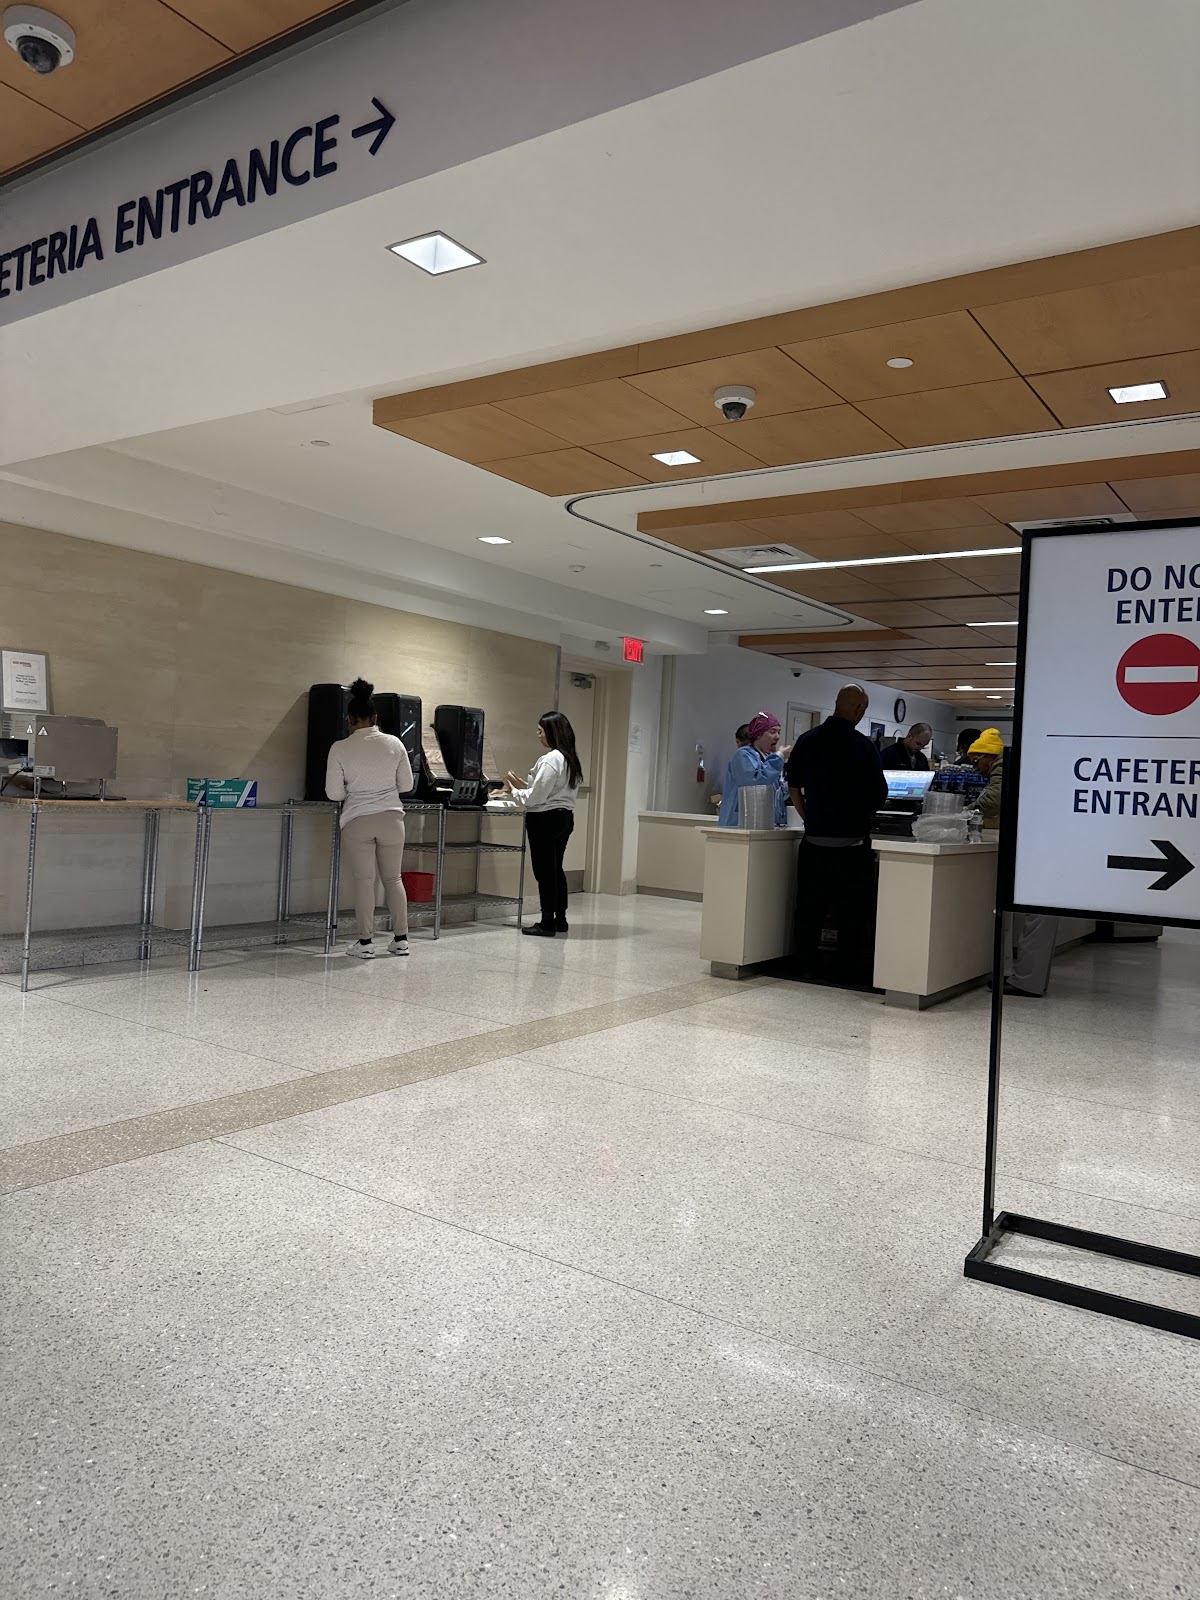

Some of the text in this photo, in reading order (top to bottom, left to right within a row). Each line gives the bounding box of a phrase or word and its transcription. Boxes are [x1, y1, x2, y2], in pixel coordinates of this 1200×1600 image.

[115, 114, 340, 253] ENTRANCE
[1107, 566, 1152, 592] DO
[1116, 596, 1200, 624] ENTE
[626, 640, 643, 661] EXIT
[1073, 788, 1198, 818] ENTRAN
